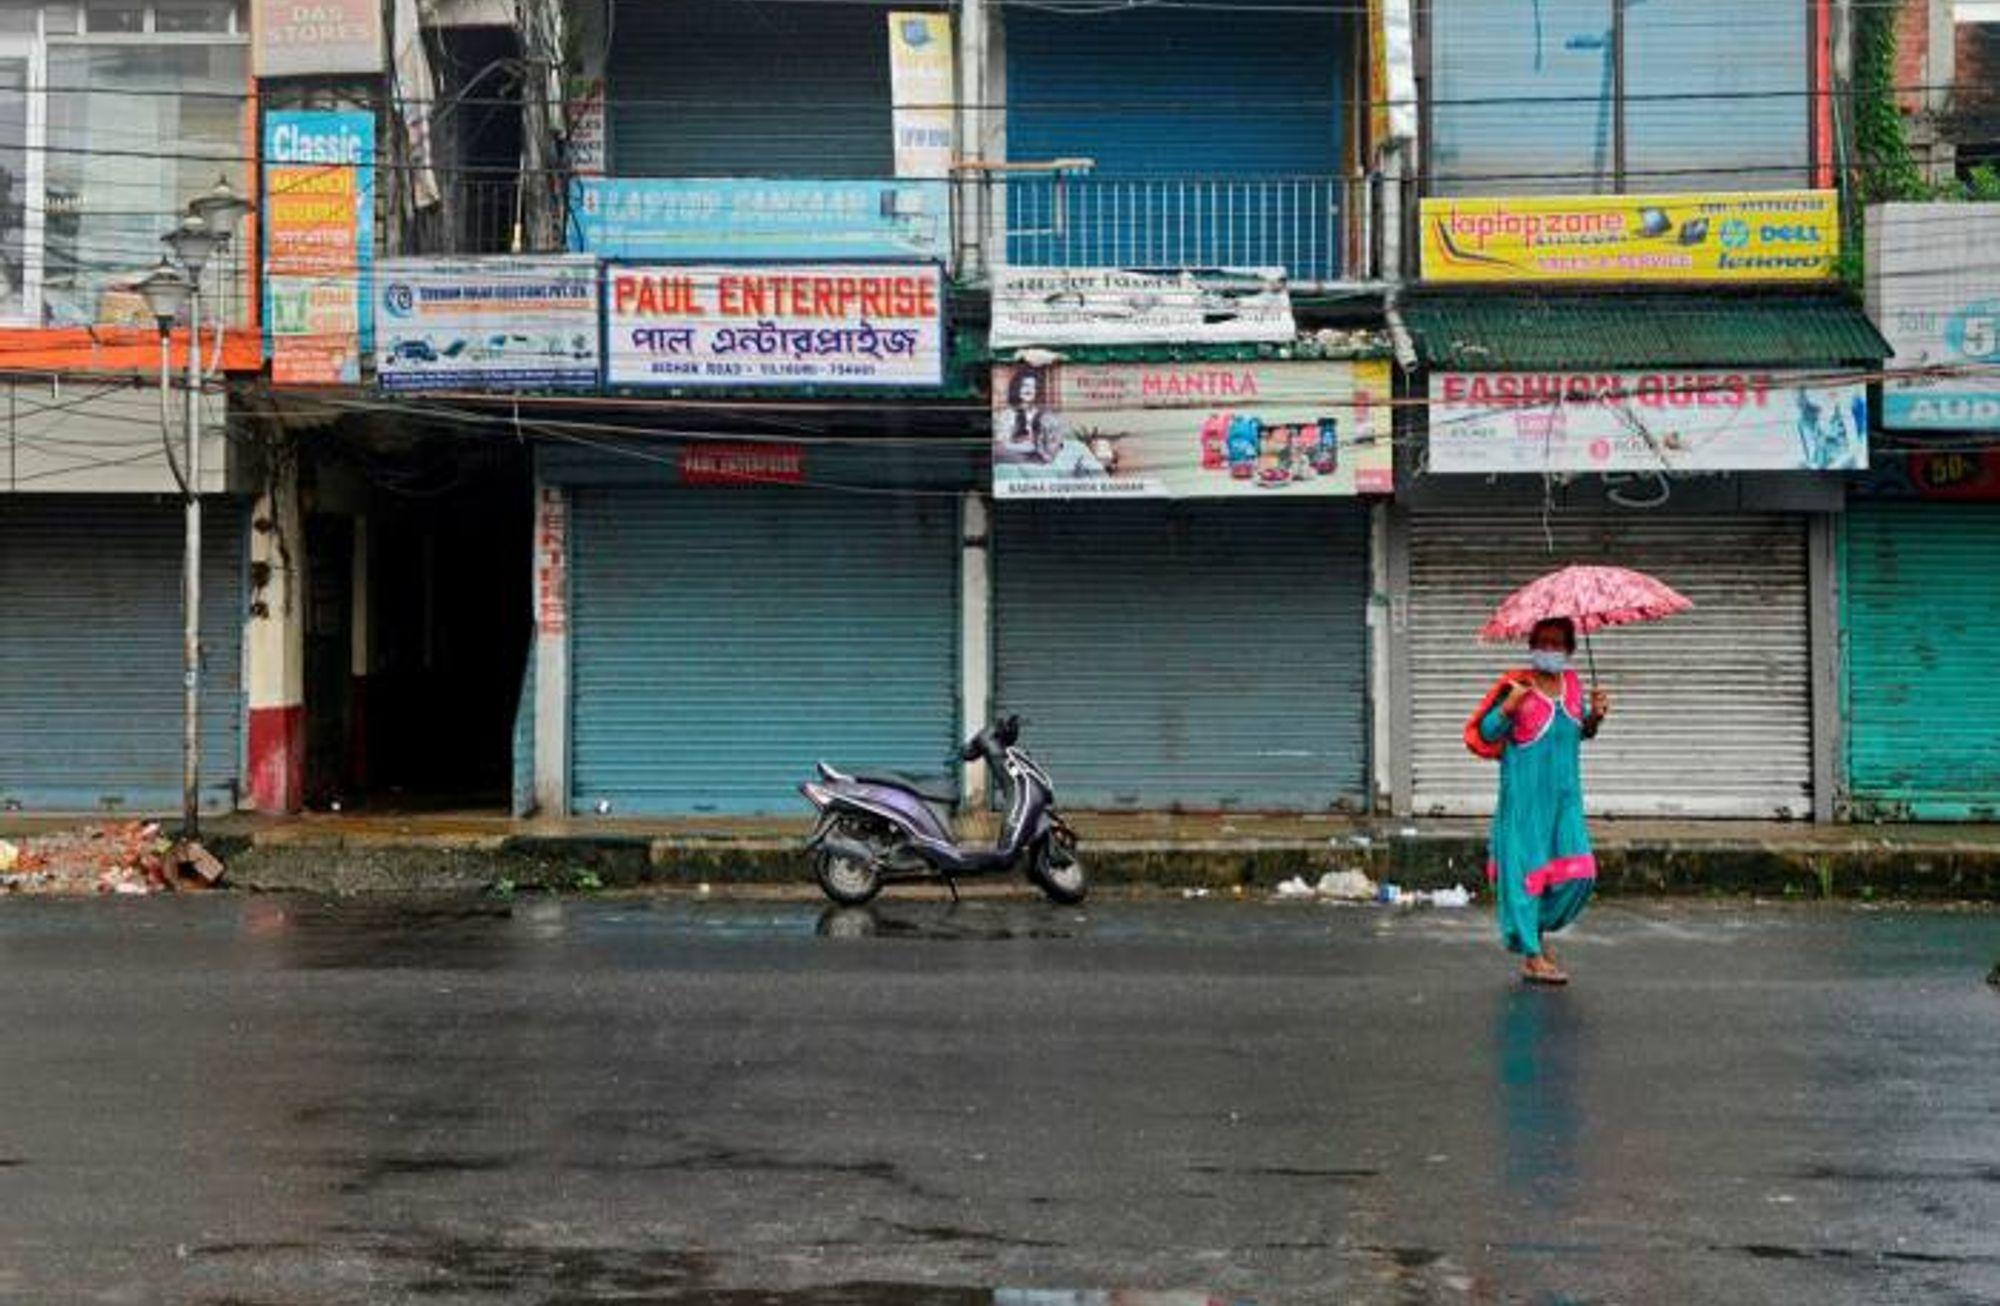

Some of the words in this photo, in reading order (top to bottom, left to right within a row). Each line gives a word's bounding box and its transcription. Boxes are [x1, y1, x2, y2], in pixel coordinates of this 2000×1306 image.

[274, 123, 362, 163] Classic
[1760, 225, 1820, 242] DELL
[1718, 252, 1822, 269] lenovo
[614, 277, 705, 315] PAUL
[718, 277, 936, 318] ENTERPRISE
[631, 327, 696, 355] পাল
[711, 318, 919, 360] এন্টারপ্রাইজ
[1142, 367, 1257, 396] MANTRA
[1443, 373, 1622, 406] FASHION
[1637, 373, 1774, 407] QUEST
